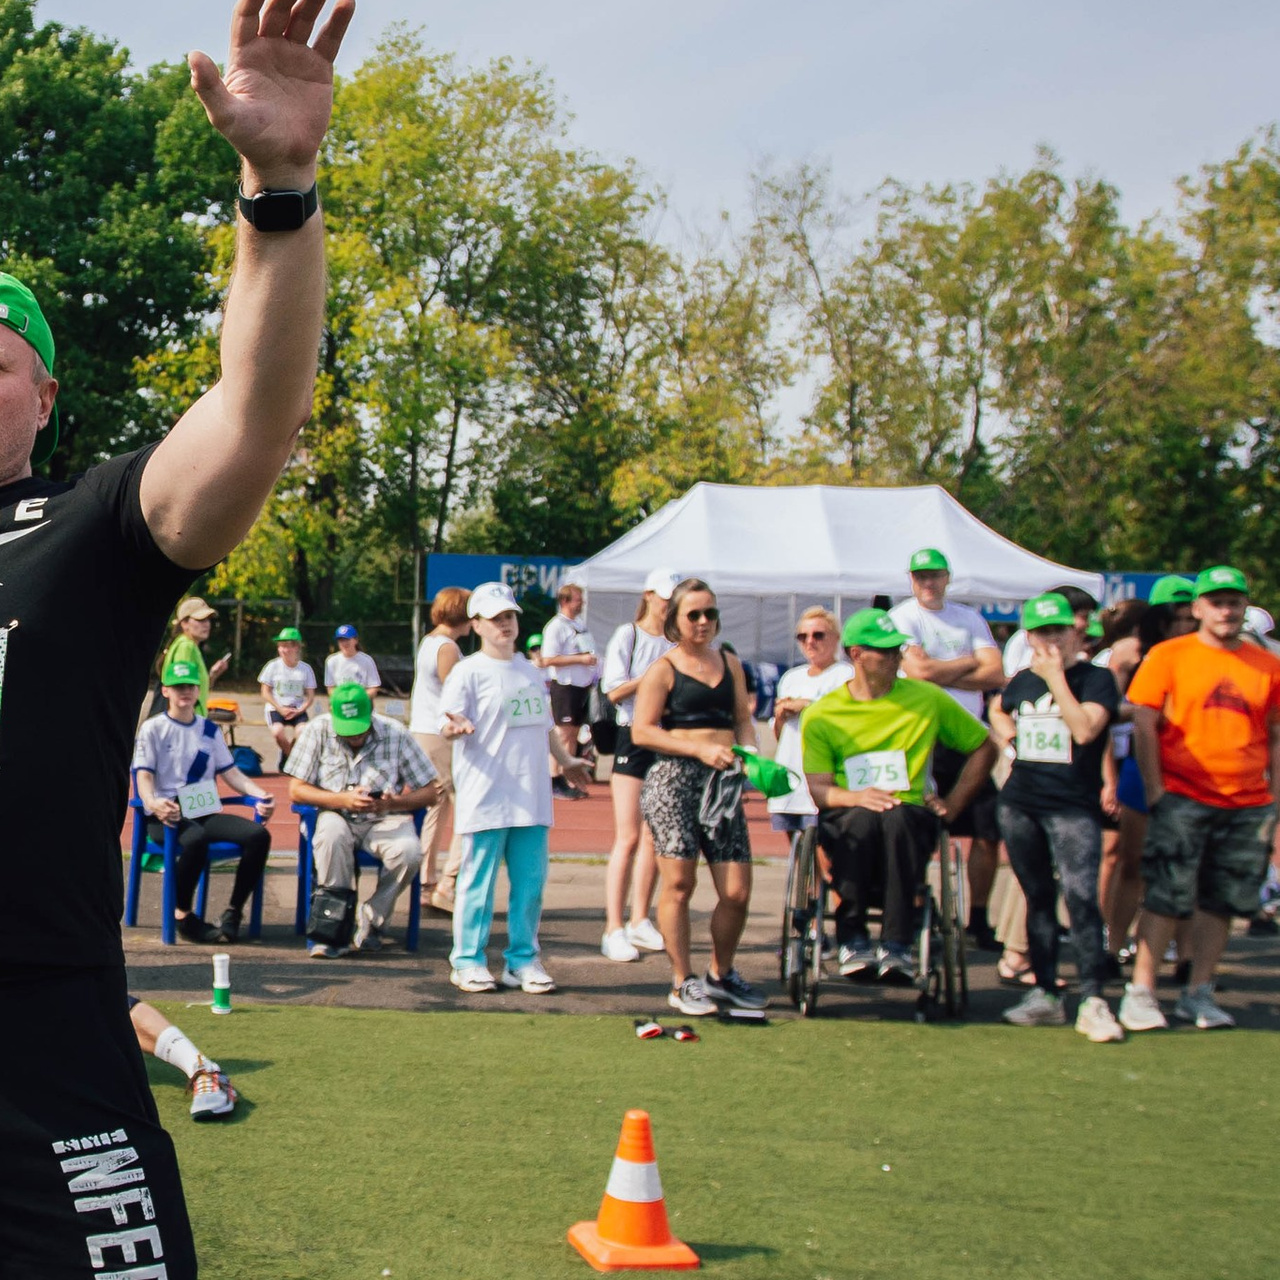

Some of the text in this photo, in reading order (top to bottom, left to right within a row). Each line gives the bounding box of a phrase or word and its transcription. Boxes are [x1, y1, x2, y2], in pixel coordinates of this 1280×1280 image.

[511, 697, 543, 716] 213
[1026, 731, 1062, 751] 184
[856, 763, 899, 785] 275
[186, 791, 215, 810] 203
